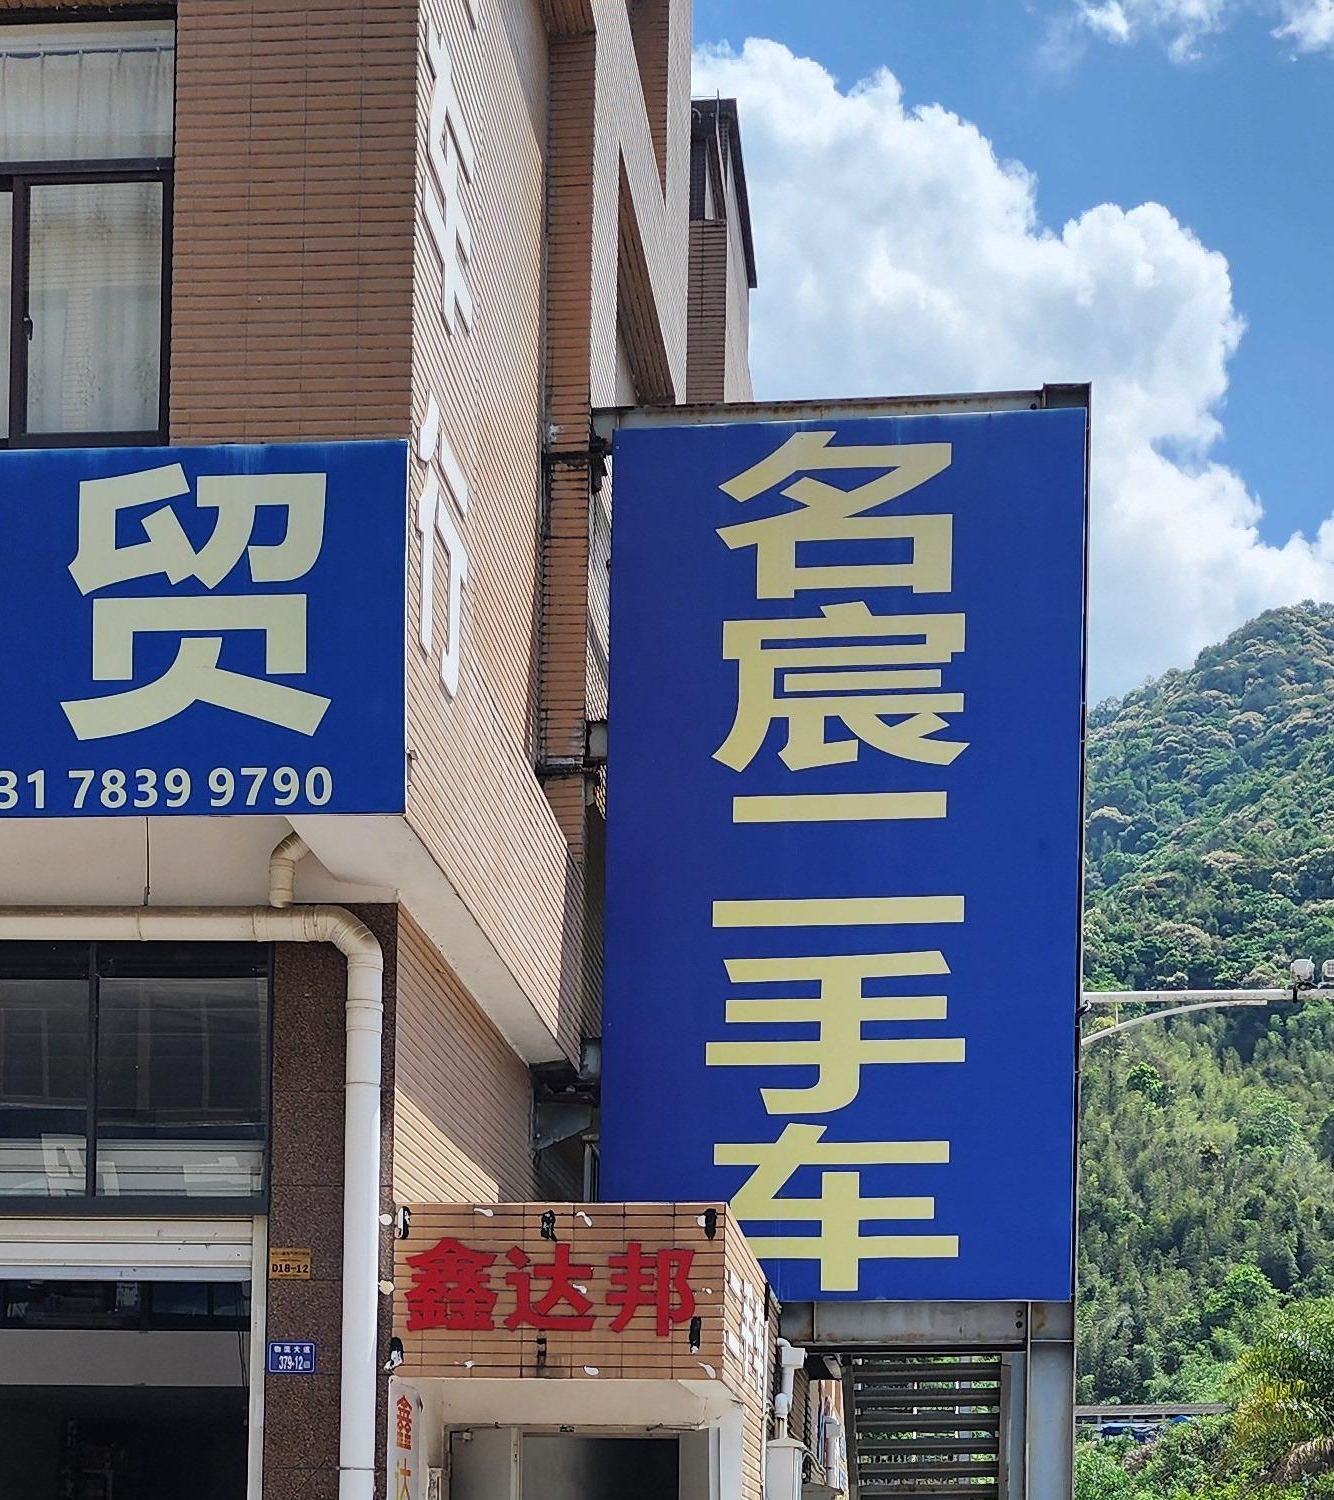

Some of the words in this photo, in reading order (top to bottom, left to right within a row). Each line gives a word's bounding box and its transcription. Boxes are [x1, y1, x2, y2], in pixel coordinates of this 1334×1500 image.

[69, 768, 192, 810] 7839
[207, 766, 334, 807] 9790
[705, 430, 971, 1292] 名宸二手车
[405, 1236, 697, 1338] 鑫达邦
